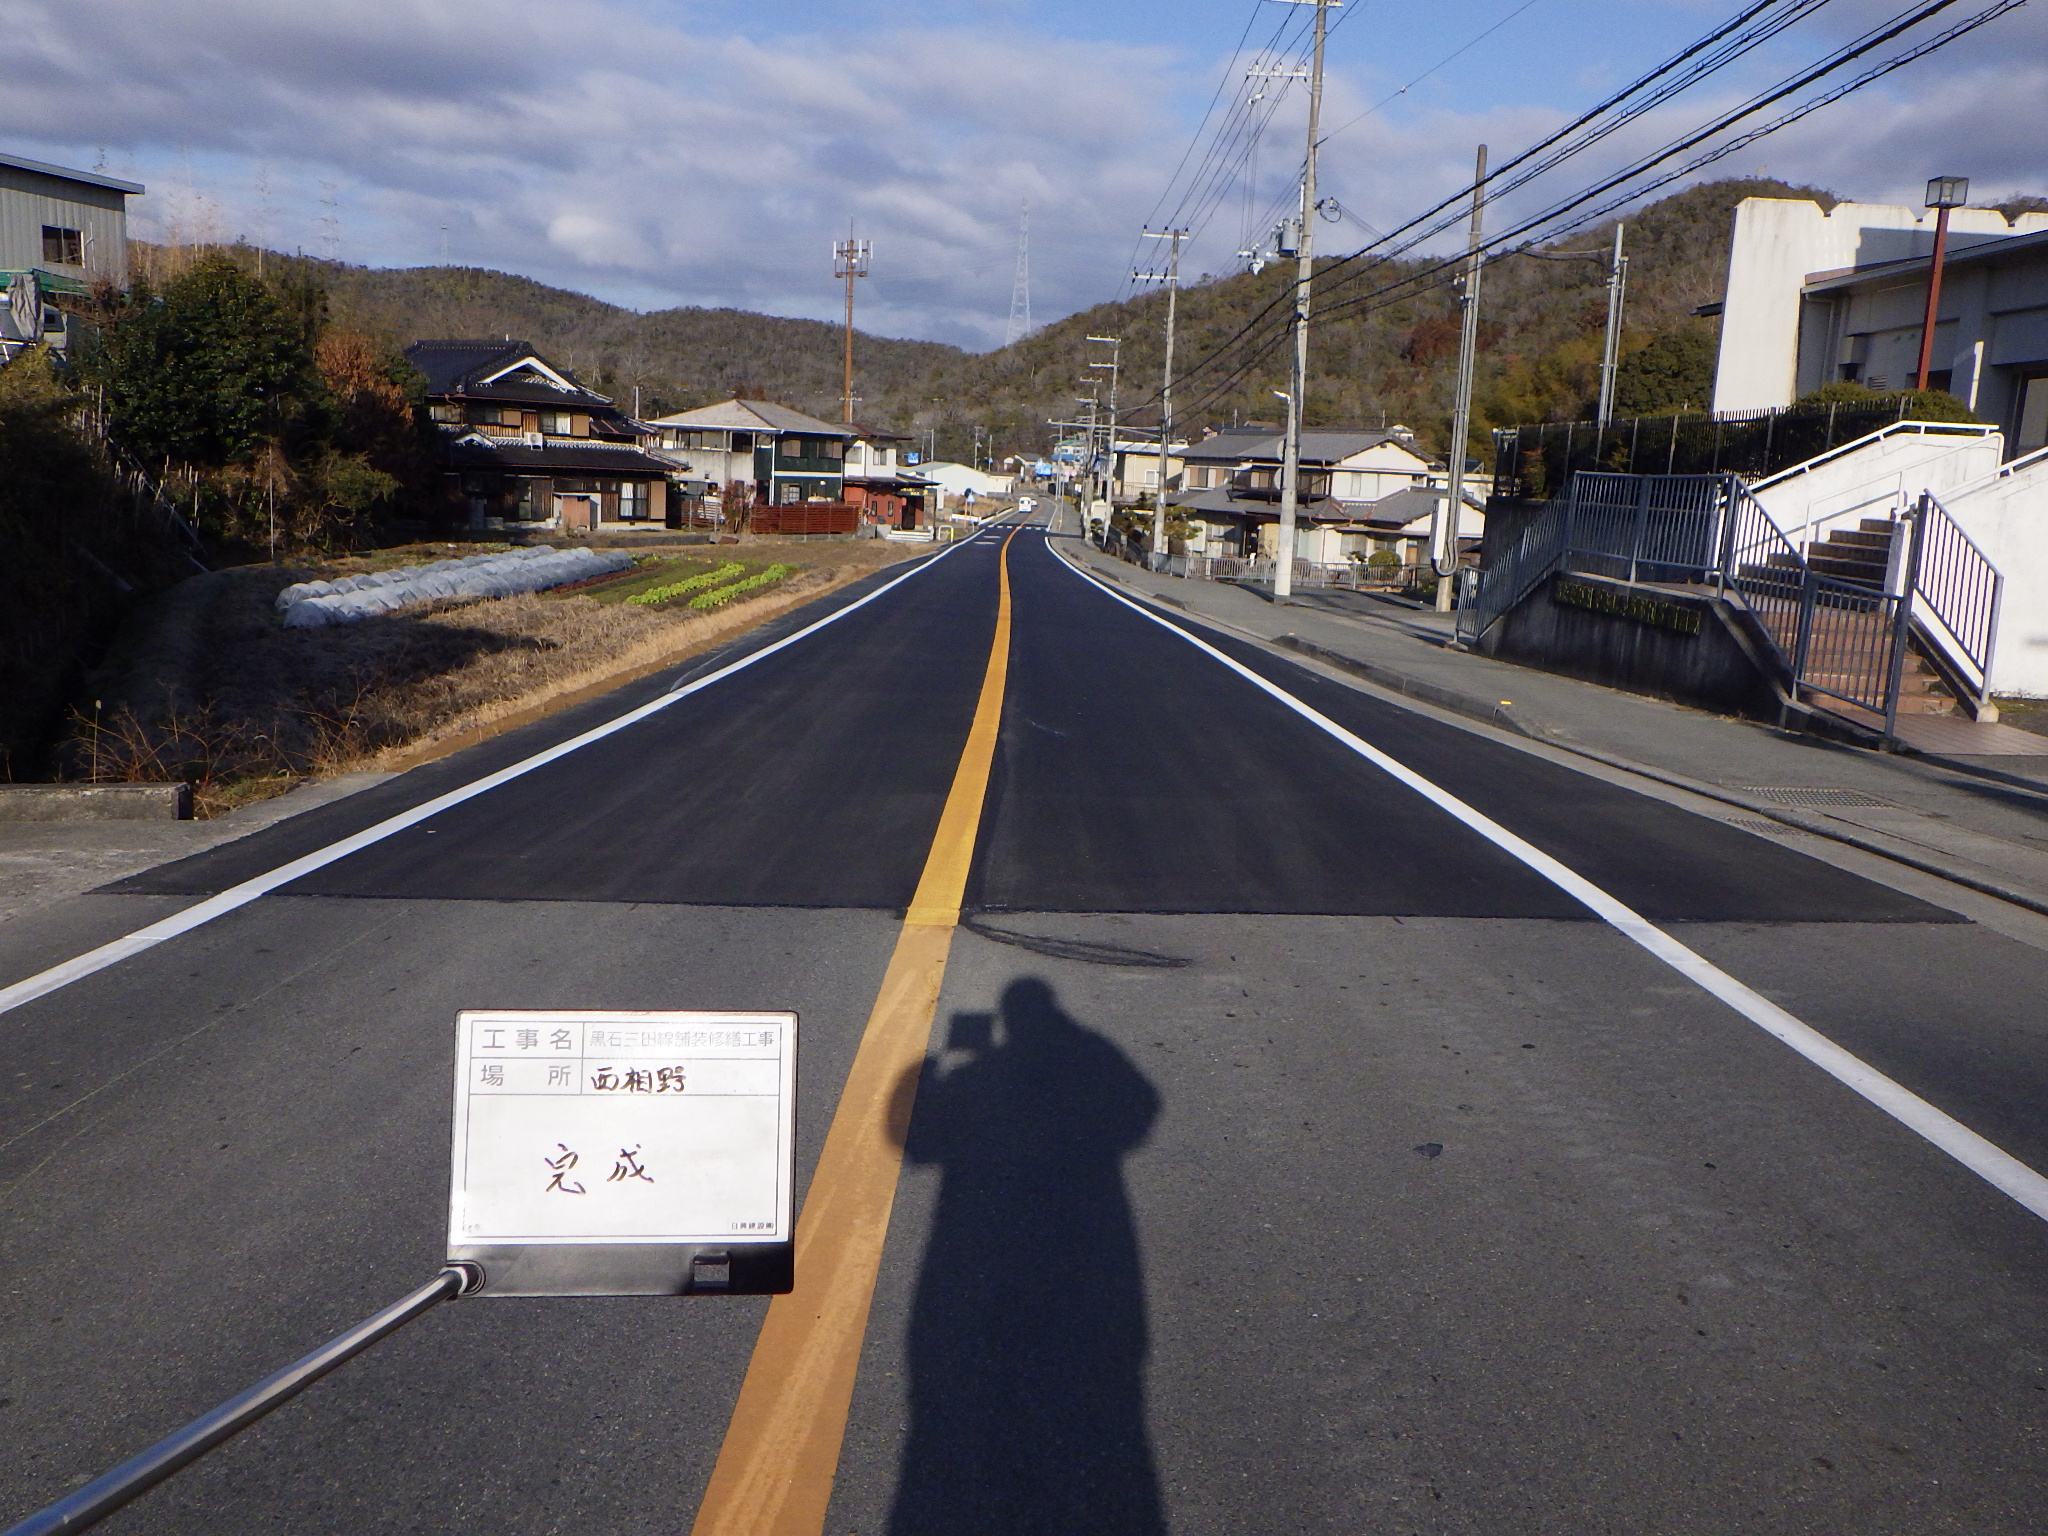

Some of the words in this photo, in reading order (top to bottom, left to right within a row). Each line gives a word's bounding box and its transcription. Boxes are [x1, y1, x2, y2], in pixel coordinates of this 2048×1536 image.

[481, 1028, 573, 1051] 工事名
[480, 1064, 572, 1087] 場所
[590, 1066, 687, 1093] 西相野
[544, 1143, 655, 1195] 完成
